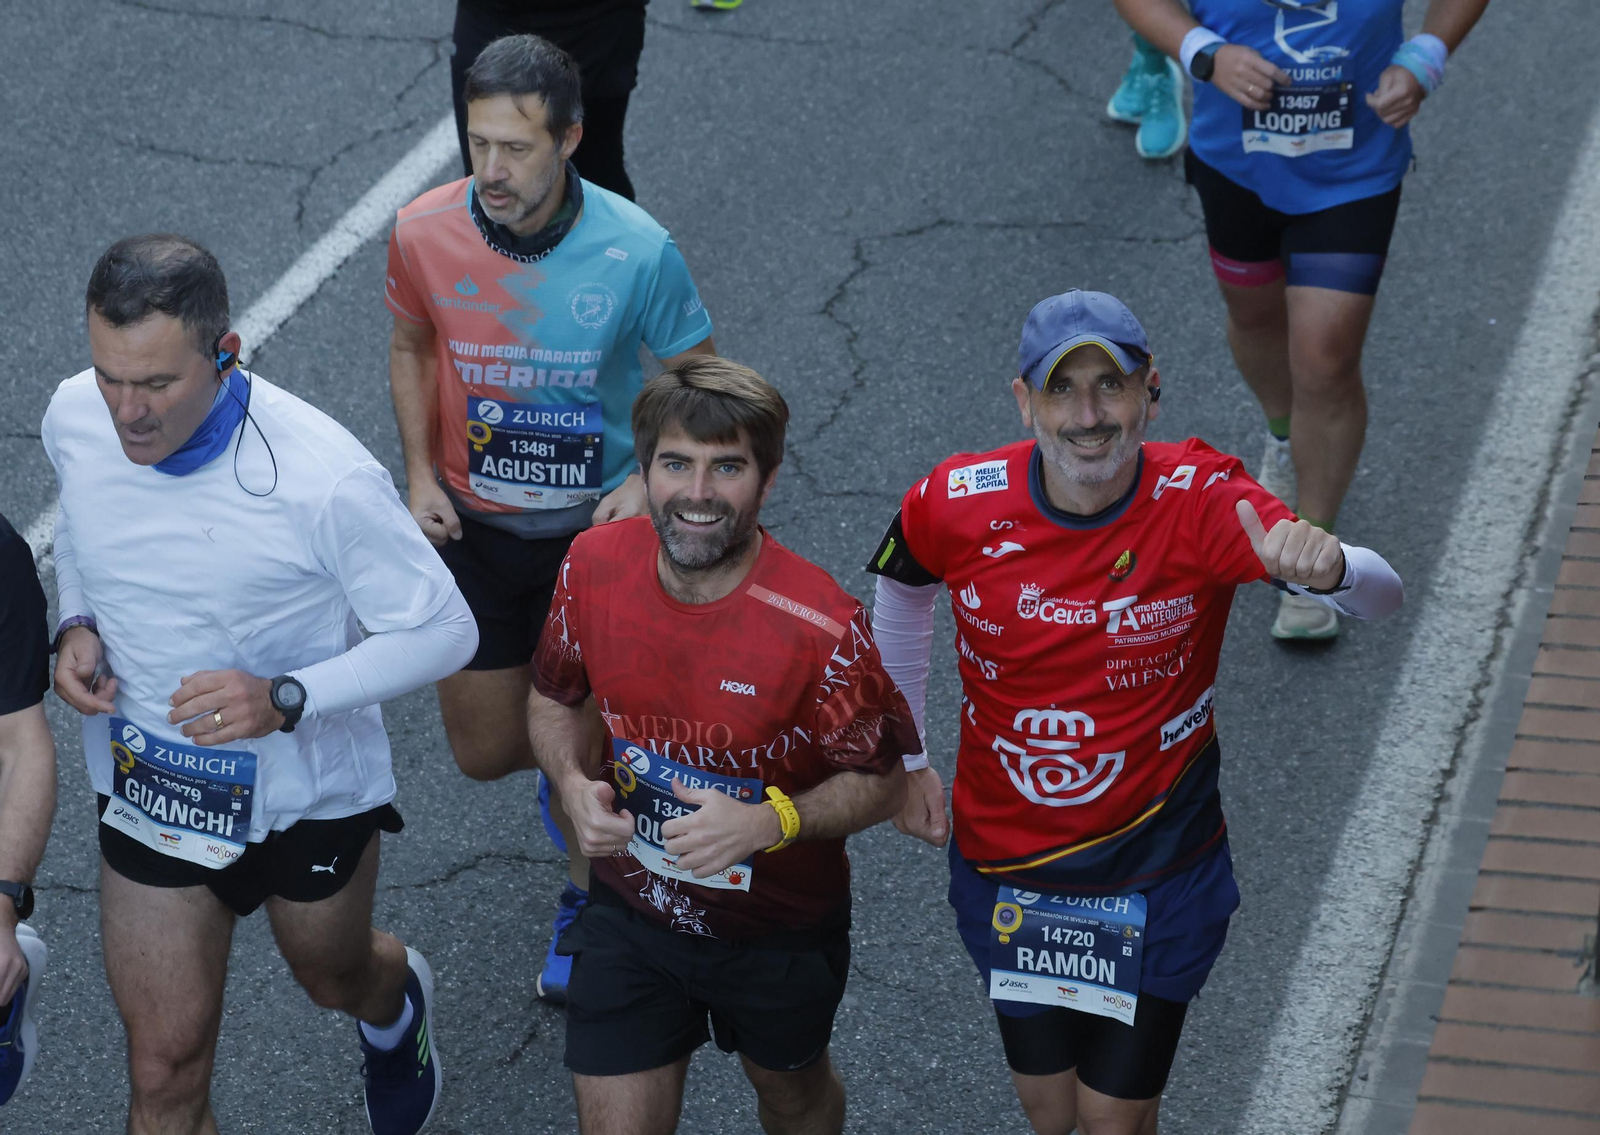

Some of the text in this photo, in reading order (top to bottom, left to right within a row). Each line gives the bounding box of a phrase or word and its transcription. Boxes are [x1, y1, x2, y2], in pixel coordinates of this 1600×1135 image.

[1279, 95, 1319, 109] 13457
[1254, 111, 1341, 133] LOOPING
[432, 293, 502, 314] Santander
[481, 345, 530, 359] MEDIA
[530, 348, 602, 364] MARATÓN
[454, 359, 597, 388] MÉRIDA
[512, 410, 585, 427] ZURICH
[510, 440, 555, 457] 13481
[481, 455, 586, 485] AGUSTIN
[975, 465, 1006, 476] MELILLA
[975, 473, 1000, 483] SPORT
[975, 479, 1008, 490] CAPITAL
[1140, 602, 1194, 625] ANTEQUERA
[1114, 633, 1159, 645] PATRIMONIO
[719, 679, 756, 697] HOKA
[621, 714, 733, 750] MEDIO
[647, 726, 812, 769] MARATÓN
[154, 745, 236, 776] ZURICH
[124, 777, 234, 837] GUANCHI
[121, 811, 140, 825] asics
[1022, 908, 1040, 916] ZURICH
[1040, 912, 1063, 920] MARATÓN
[1070, 916, 1087, 924] SEVILLA
[1041, 925, 1095, 947] 14720
[1017, 946, 1116, 985] RAMÓN
[1008, 980, 1028, 989] asics
